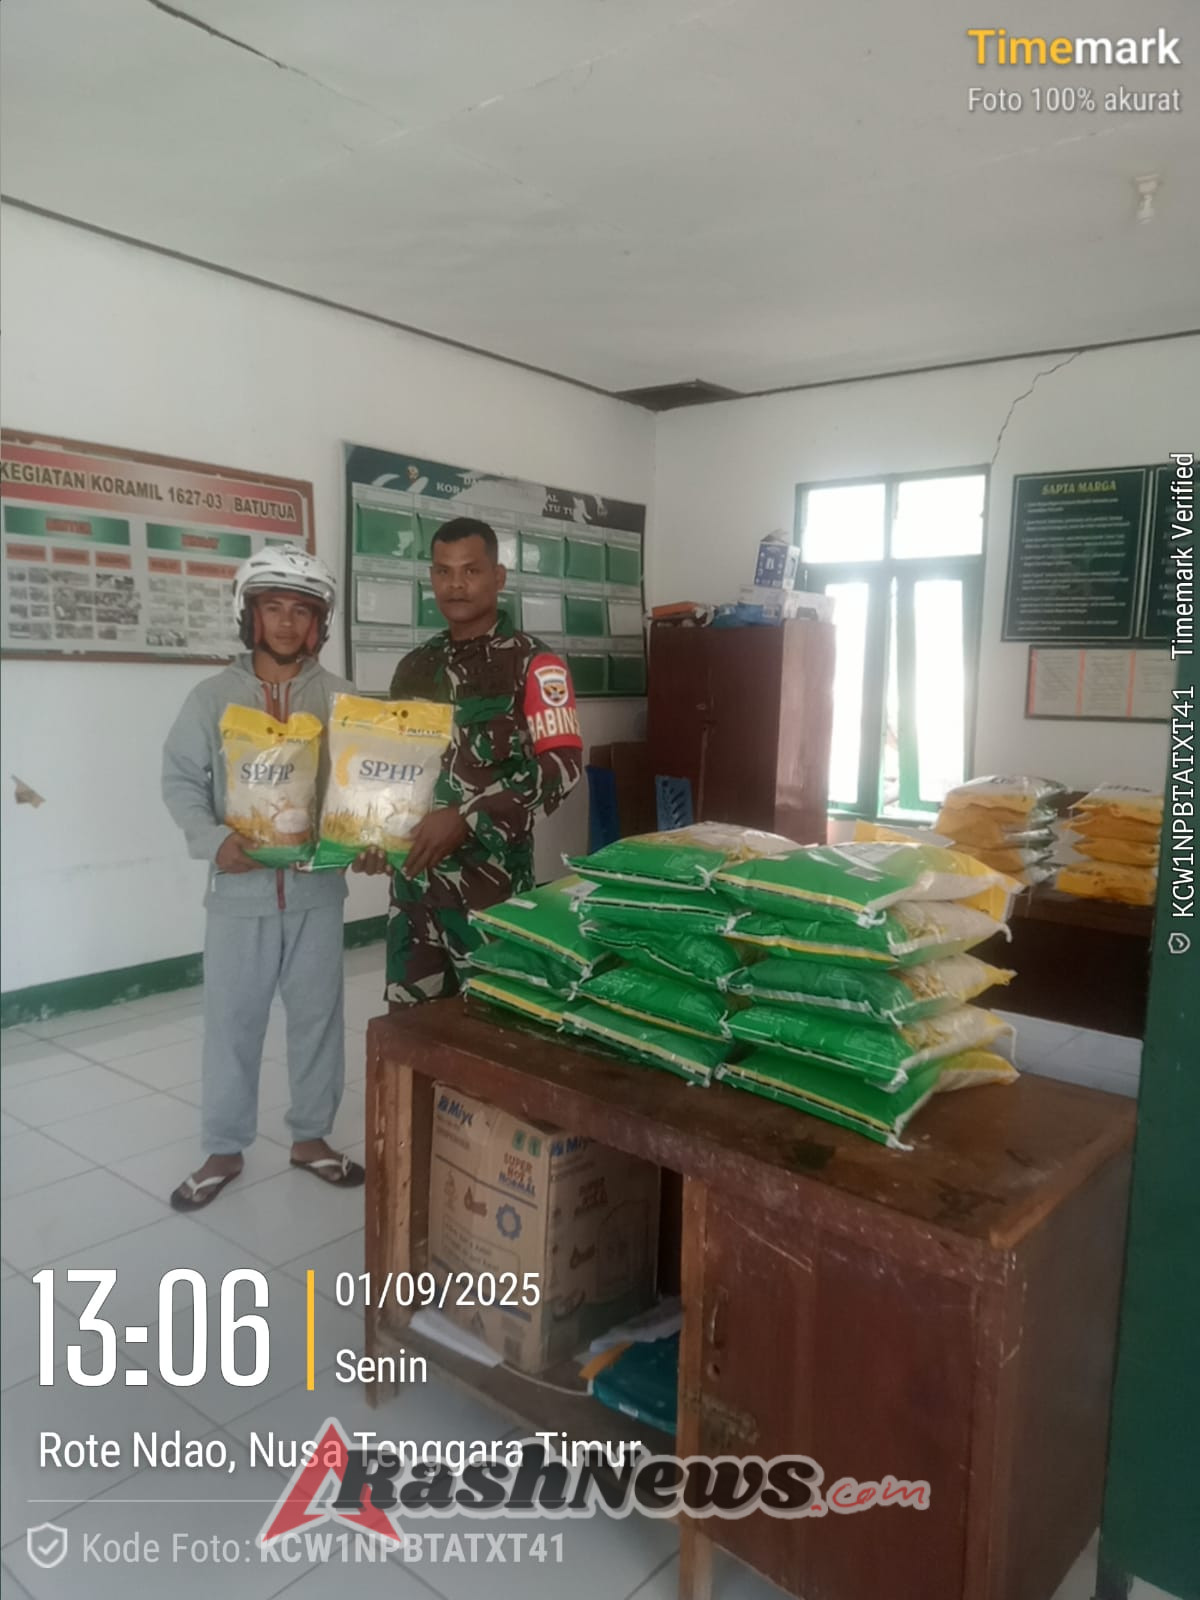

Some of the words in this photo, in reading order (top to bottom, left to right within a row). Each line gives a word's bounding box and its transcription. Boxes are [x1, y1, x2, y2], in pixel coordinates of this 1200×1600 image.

[0, 460, 86, 490] KEGIATAN
[91, 474, 163, 501] KORAMIL
[168, 486, 222, 510] 1627-03
[233, 495, 296, 521] BATUTUA
[1078, 479, 1117, 493] MARGA
[241, 761, 295, 782] SPHP
[358, 759, 424, 784] SPHP
